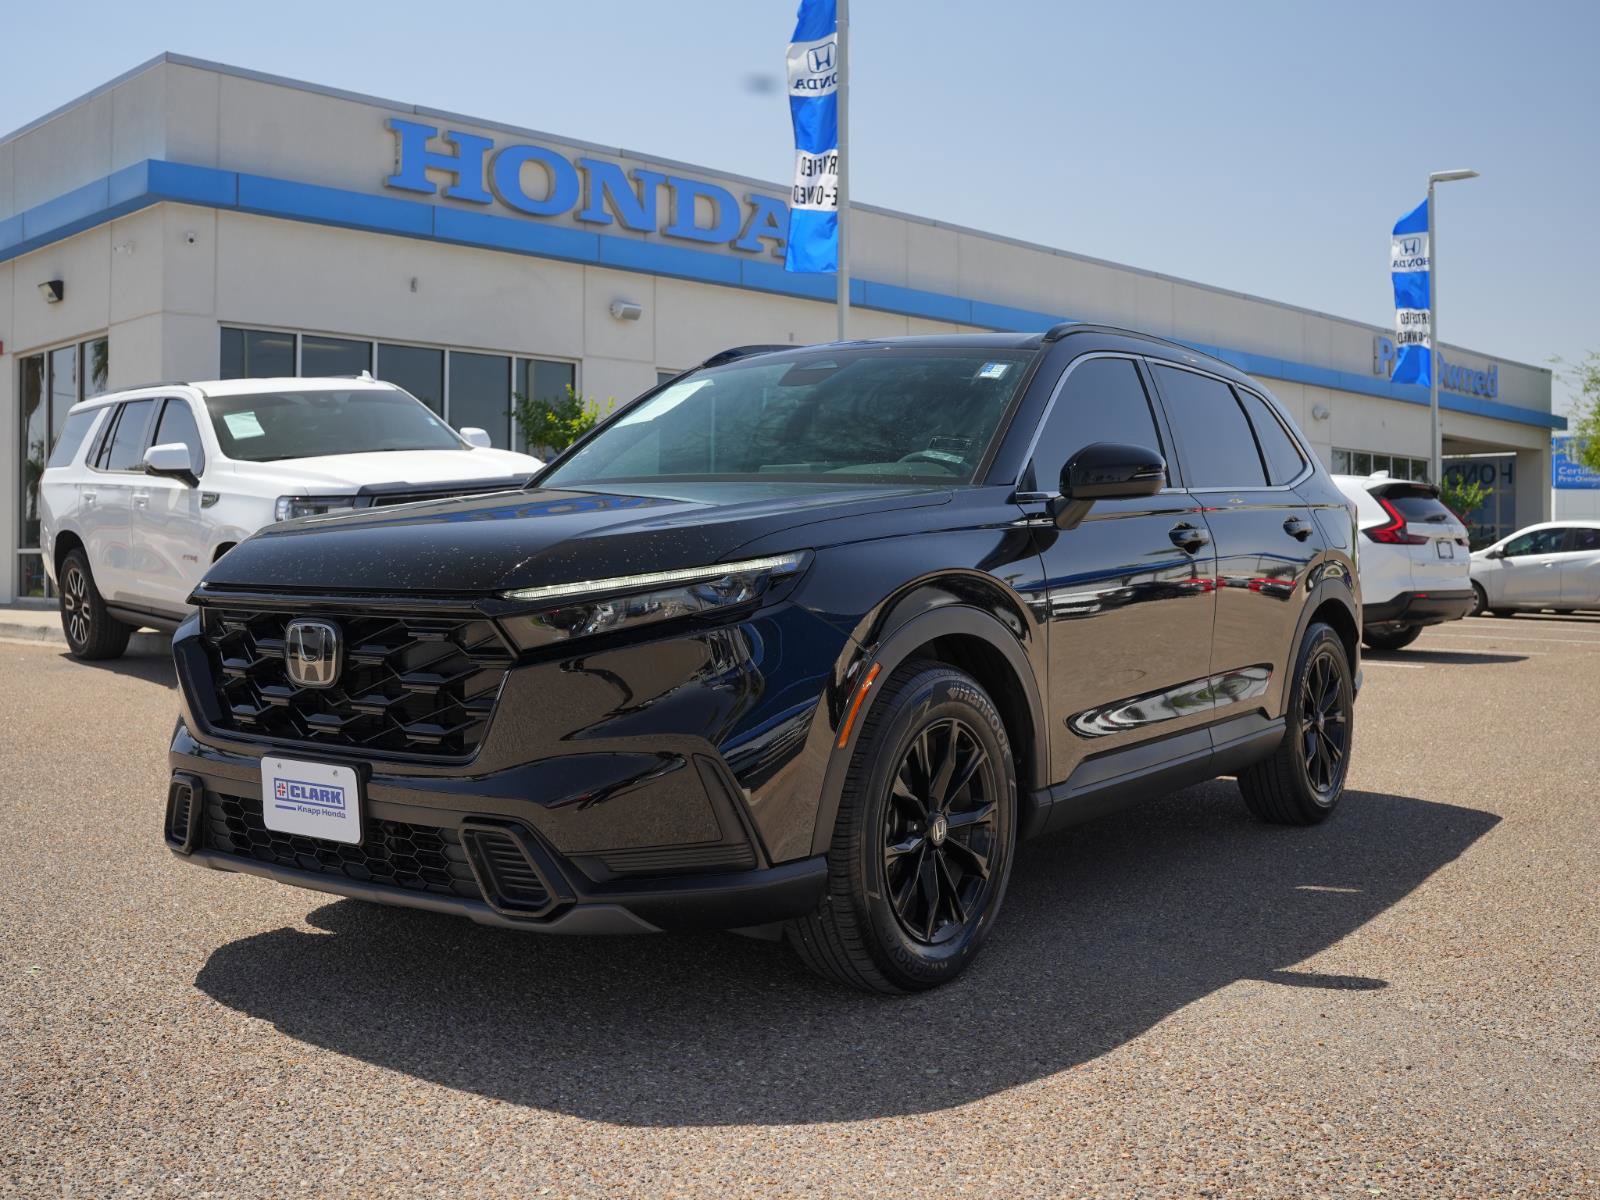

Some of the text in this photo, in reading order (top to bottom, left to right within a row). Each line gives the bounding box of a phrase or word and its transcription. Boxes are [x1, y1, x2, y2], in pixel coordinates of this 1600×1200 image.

[384, 118, 790, 260] HONDA
[290, 785, 342, 804] CLARK
[297, 805, 346, 819] Knapp Honda
